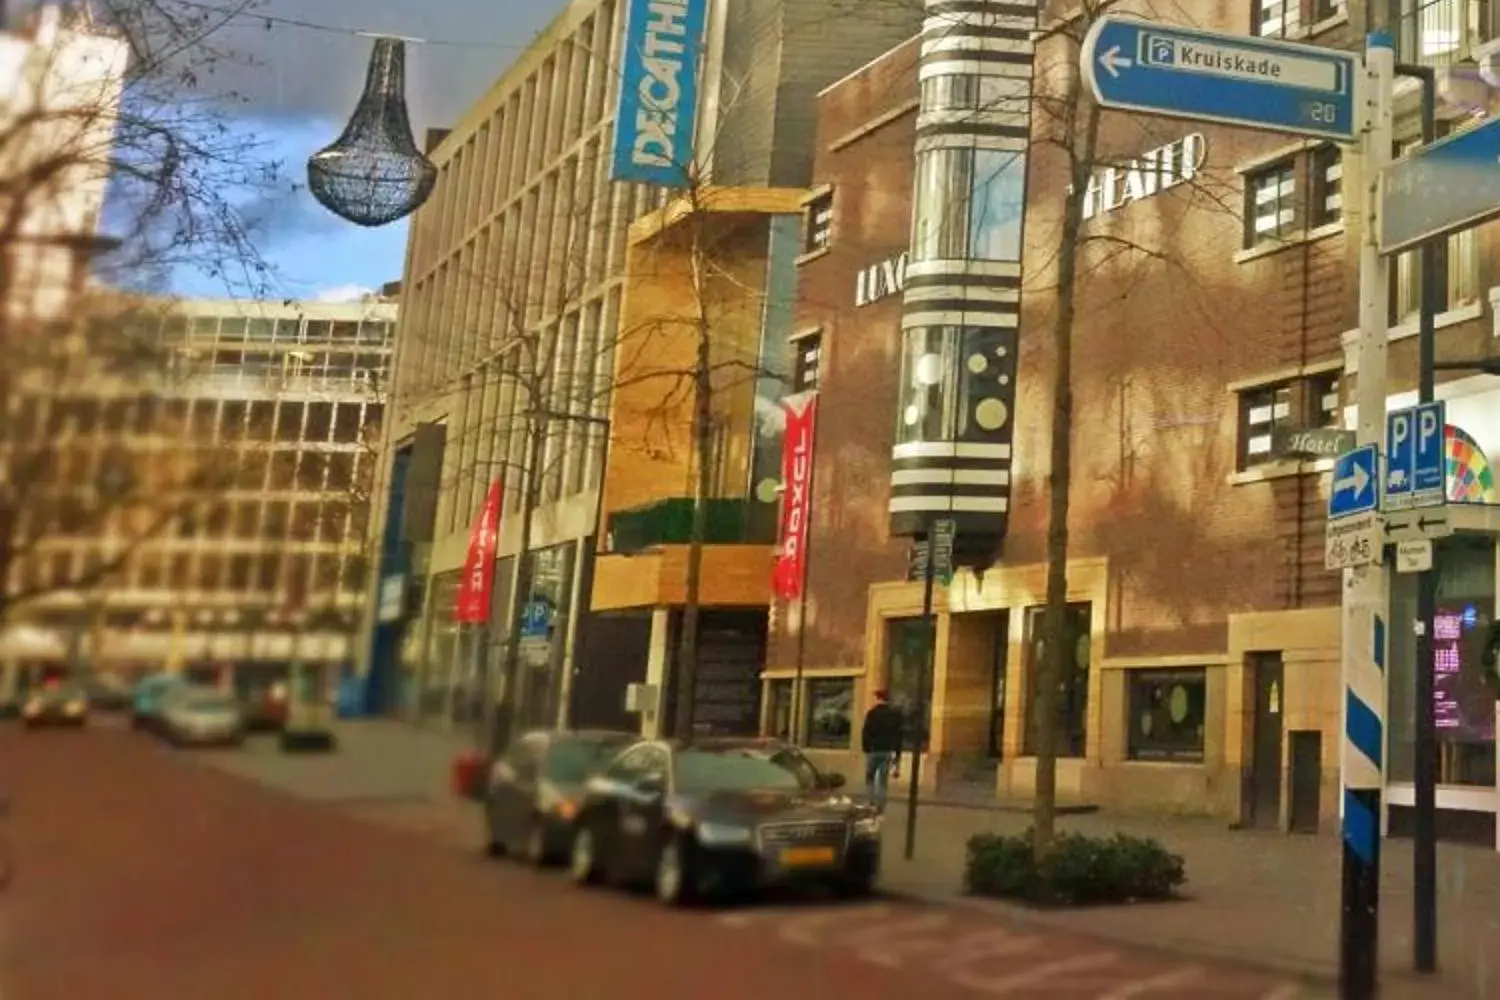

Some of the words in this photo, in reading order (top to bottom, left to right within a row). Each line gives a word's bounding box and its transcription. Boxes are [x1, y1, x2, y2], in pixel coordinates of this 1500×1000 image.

[1181, 47, 1281, 77] Kruiskade
[1288, 432, 1346, 453] Hotel
[1392, 416, 1408, 458] P
[1420, 410, 1437, 454] P
